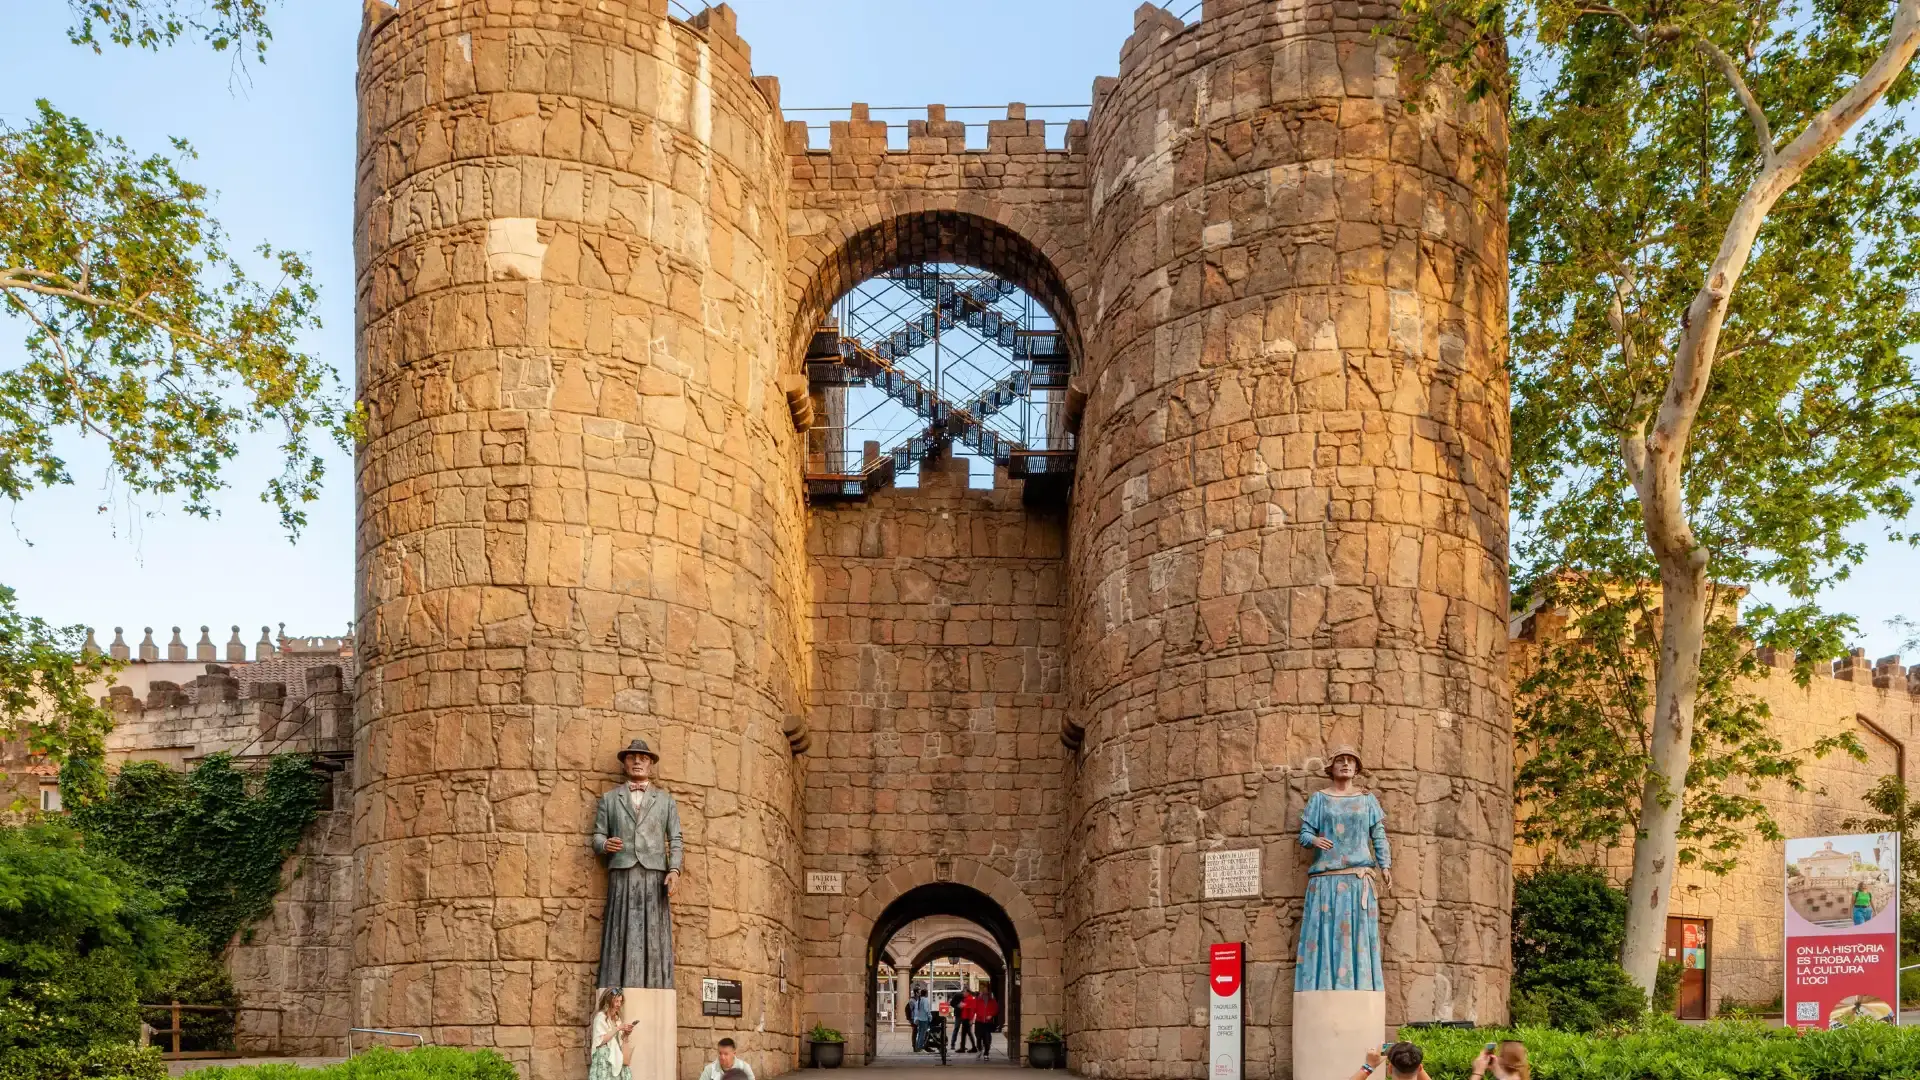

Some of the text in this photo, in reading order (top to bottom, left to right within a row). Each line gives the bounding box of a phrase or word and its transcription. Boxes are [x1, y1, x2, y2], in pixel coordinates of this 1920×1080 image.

[1796, 943, 1885, 955] ON LA HISTÒRIA
[1796, 954, 1880, 965] ES TROBA AMB
[1796, 965, 1865, 975] LA CULTURA
[1796, 976, 1828, 985] I L'OCI
